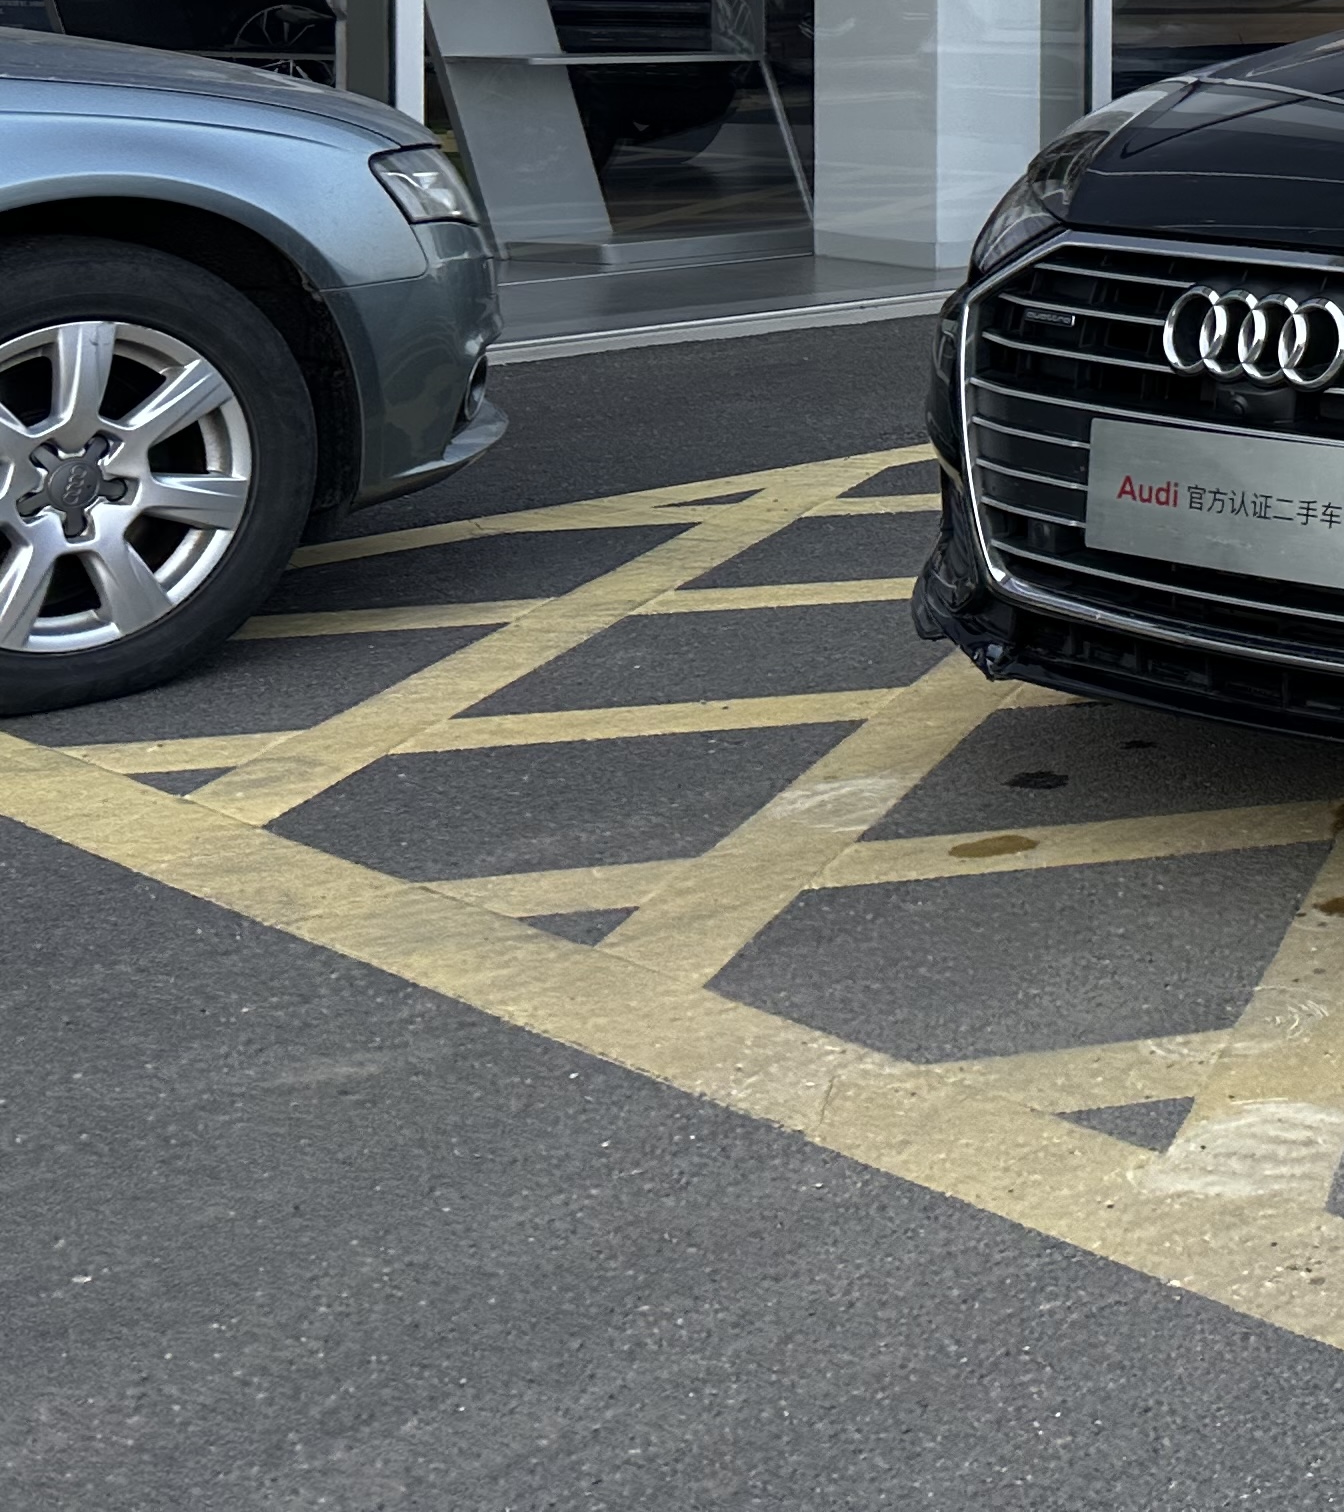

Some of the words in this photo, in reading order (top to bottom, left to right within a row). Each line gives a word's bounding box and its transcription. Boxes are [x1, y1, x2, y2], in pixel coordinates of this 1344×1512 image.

[1116, 475, 1179, 508] Audi
[1187, 484, 1343, 529] 官方认证二手车
